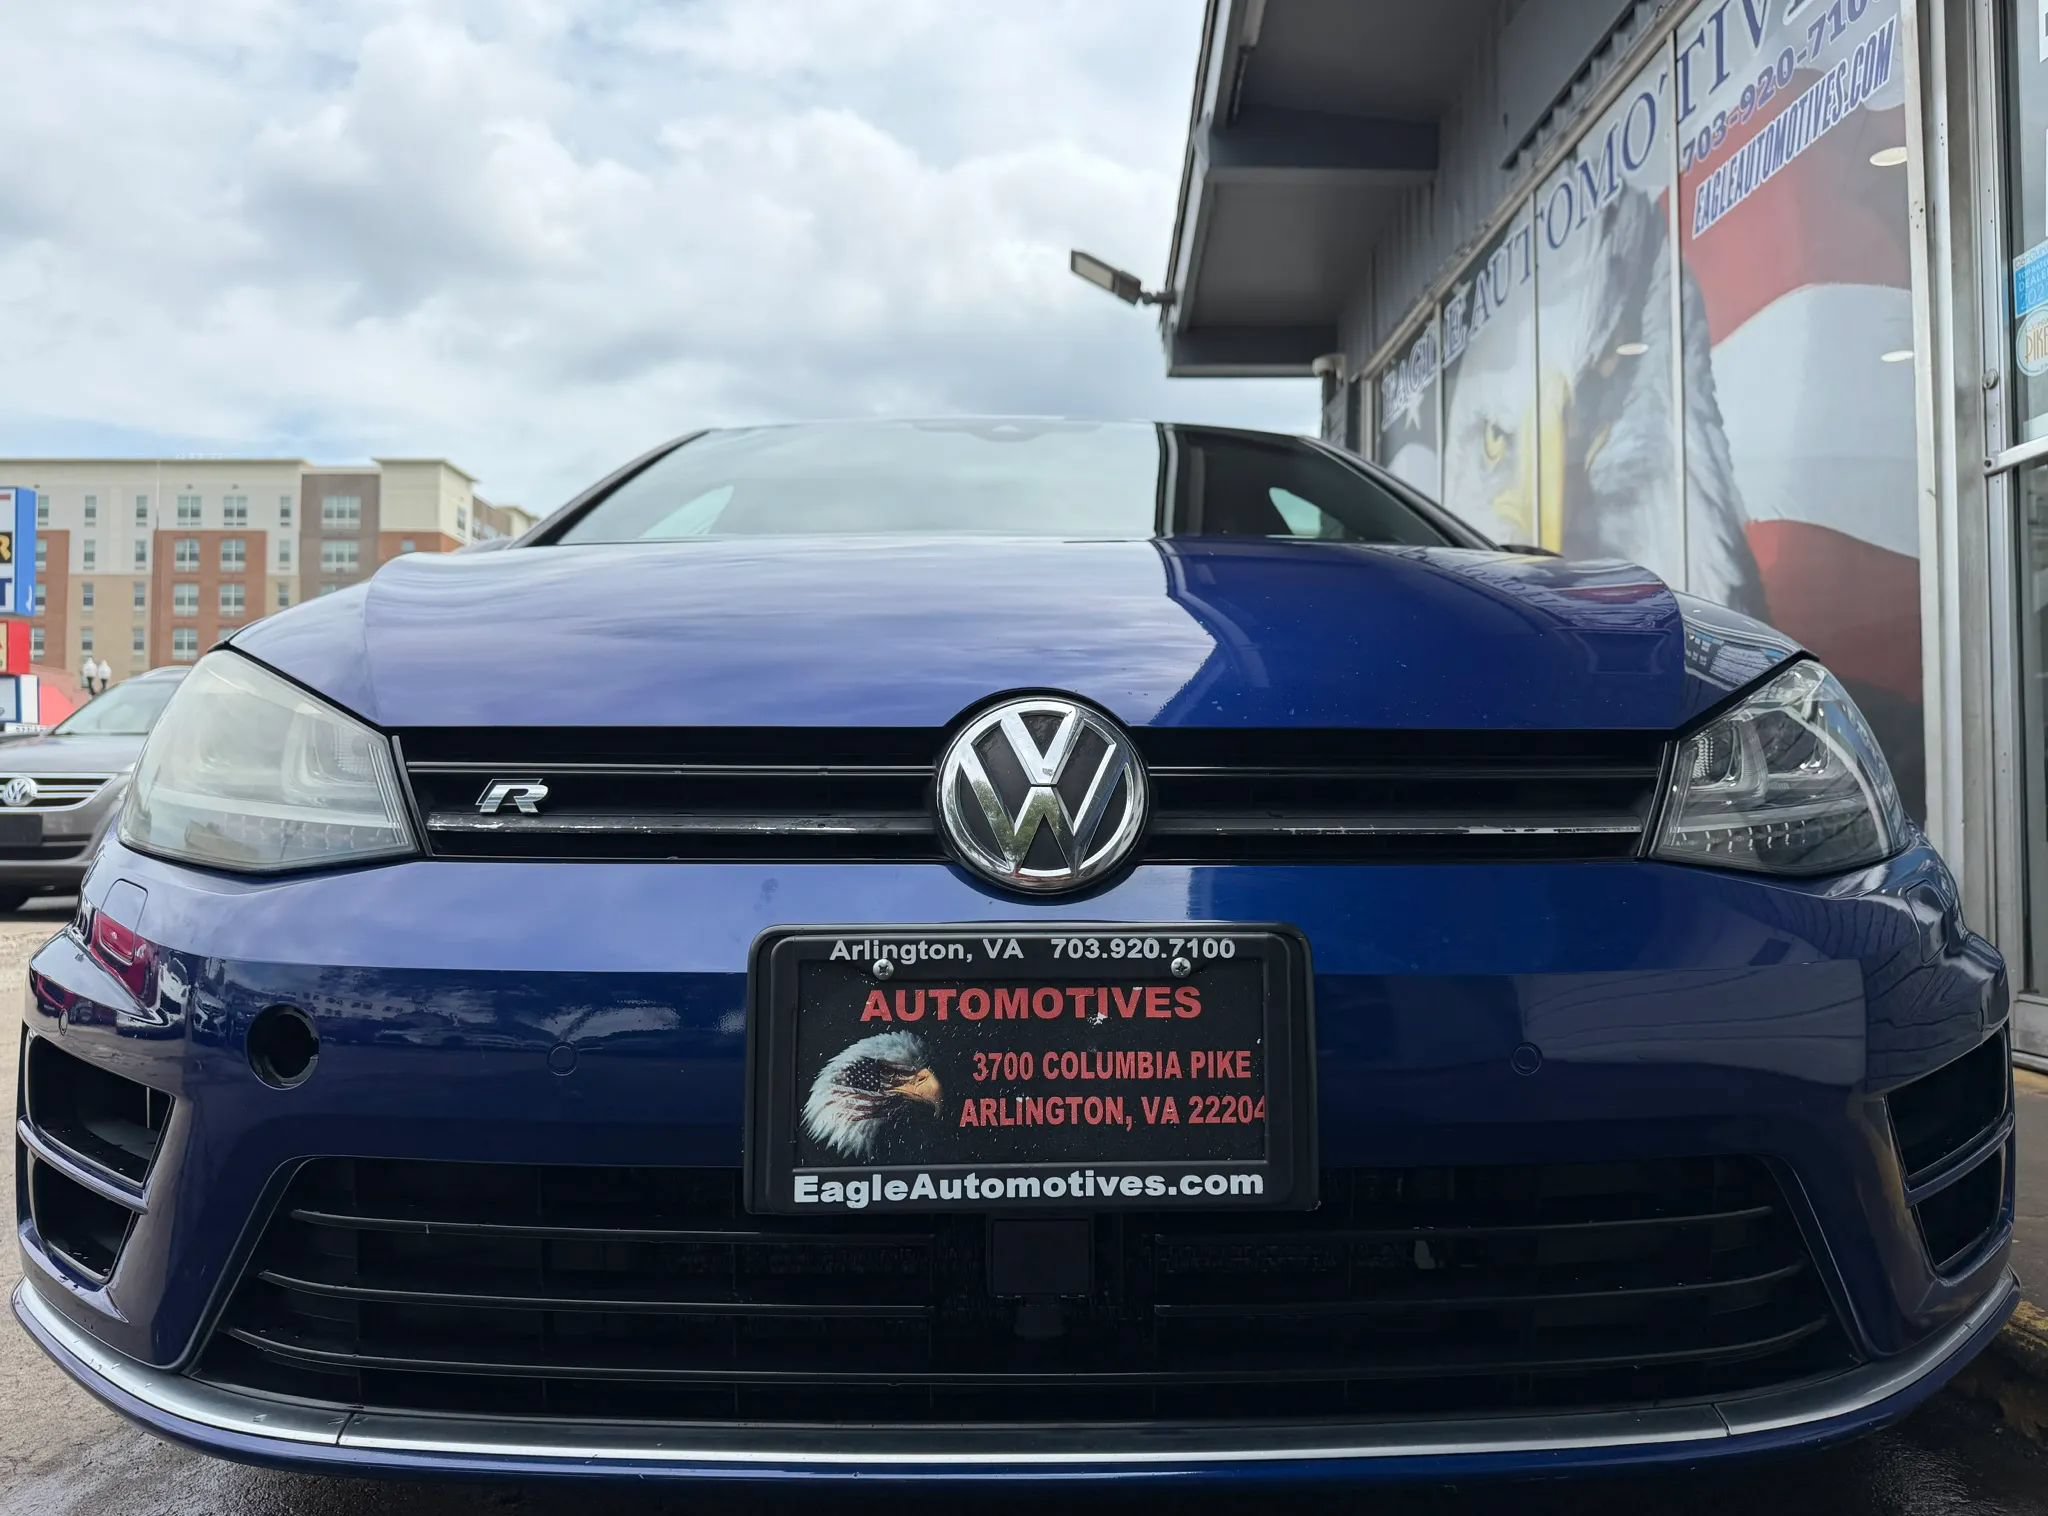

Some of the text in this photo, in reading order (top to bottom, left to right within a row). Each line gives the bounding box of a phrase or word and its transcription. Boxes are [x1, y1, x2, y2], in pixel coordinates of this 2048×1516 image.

[1683, 0, 1882, 174] 703-920-710
[1692, 13, 1897, 240] EAGLEAUTOMOTIVES.COM
[475, 779, 549, 813] R
[938, 698, 1148, 894] VW
[829, 938, 1236, 965] Arlington, VA 703.920.7100
[860, 986, 1202, 1022] AUTOMOTIVES
[972, 1050, 1252, 1081] 3700 COLUMBIA PIKE
[959, 1095, 1267, 1131] ARLINGTON, VA 22204
[793, 1169, 1265, 1208] EagleAutomotives.com
